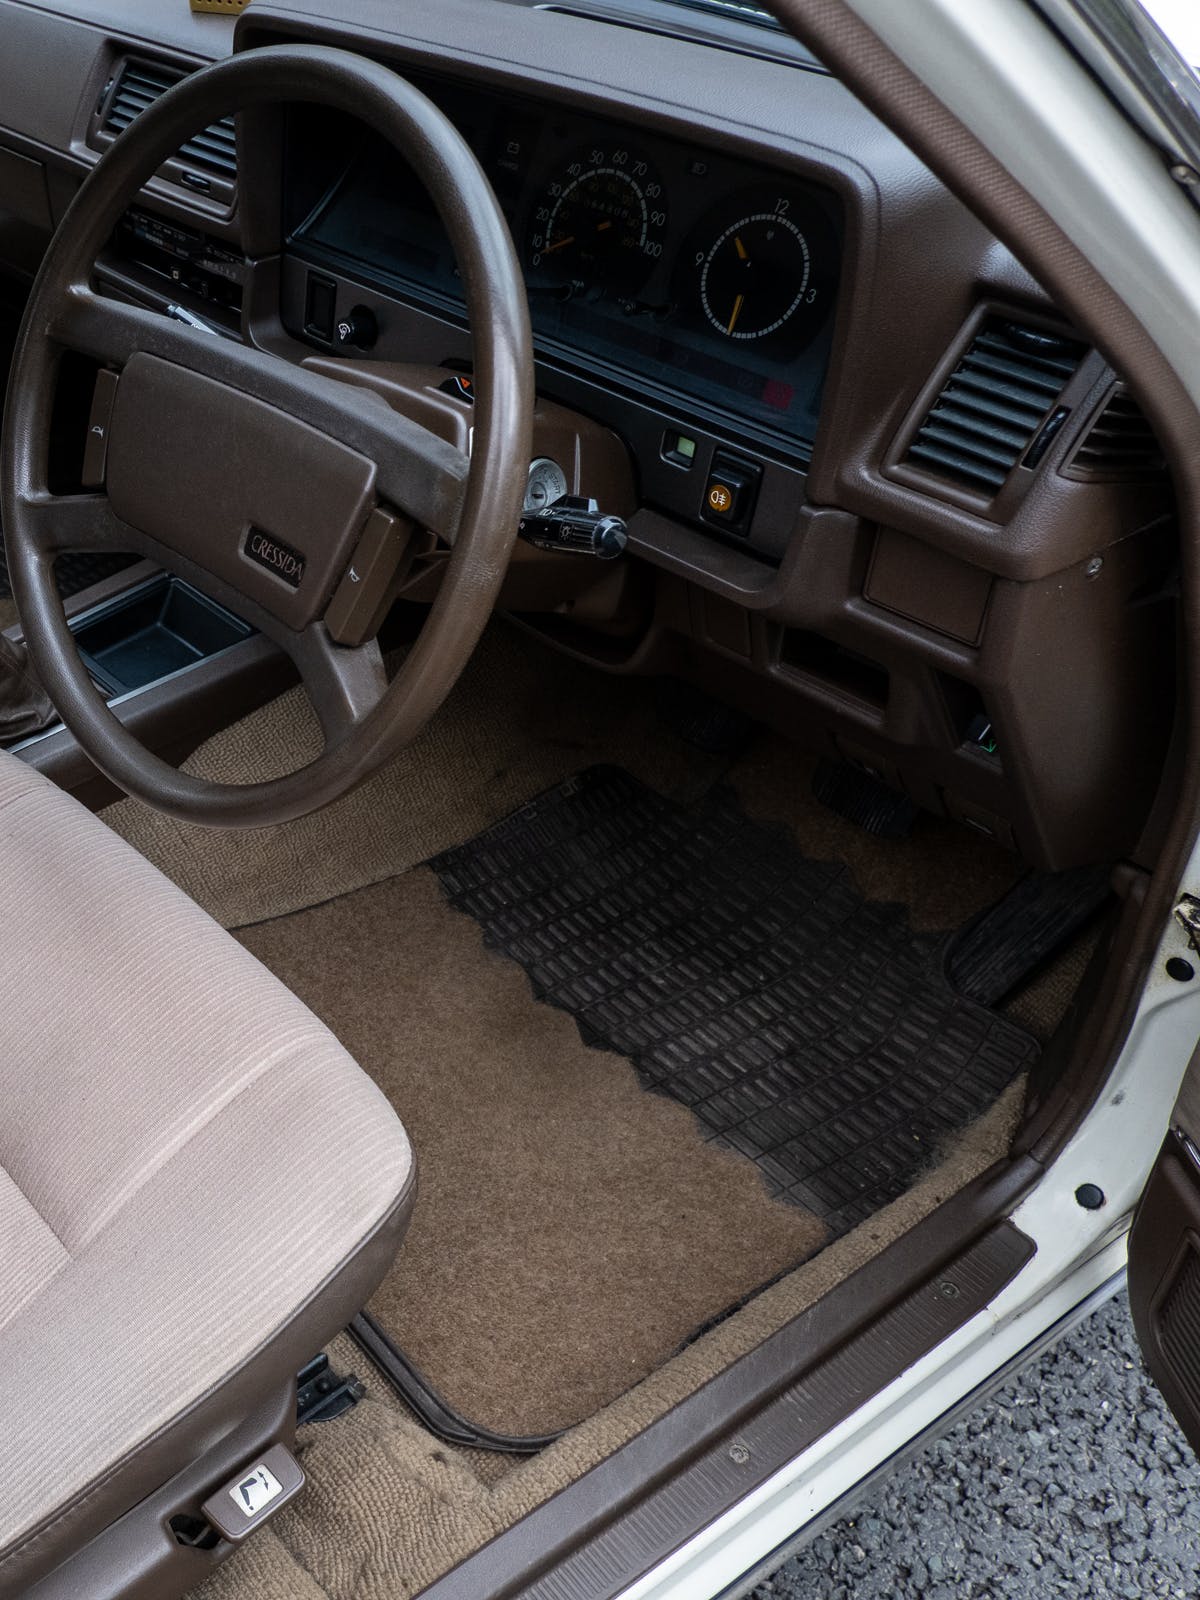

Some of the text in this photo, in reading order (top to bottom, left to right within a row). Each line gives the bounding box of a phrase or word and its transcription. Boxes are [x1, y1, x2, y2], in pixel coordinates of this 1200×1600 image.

[590, 150, 604, 165] 50
[612, 152, 629, 165] 60
[568, 163, 582, 177] 40
[633, 159, 648, 176] 70
[547, 183, 561, 197] 30
[646, 183, 661, 198] 80
[774, 198, 790, 215] 12
[536, 208, 550, 221] 20
[650, 211, 666, 227] 90
[533, 235, 543, 248] 10
[645, 242, 663, 257] 100
[533, 256, 541, 266] 0
[695, 252, 704, 267] 9
[805, 289, 817, 304] 3
[550, 473, 561, 494] START
[251, 535, 302, 580] CRESSIDA
